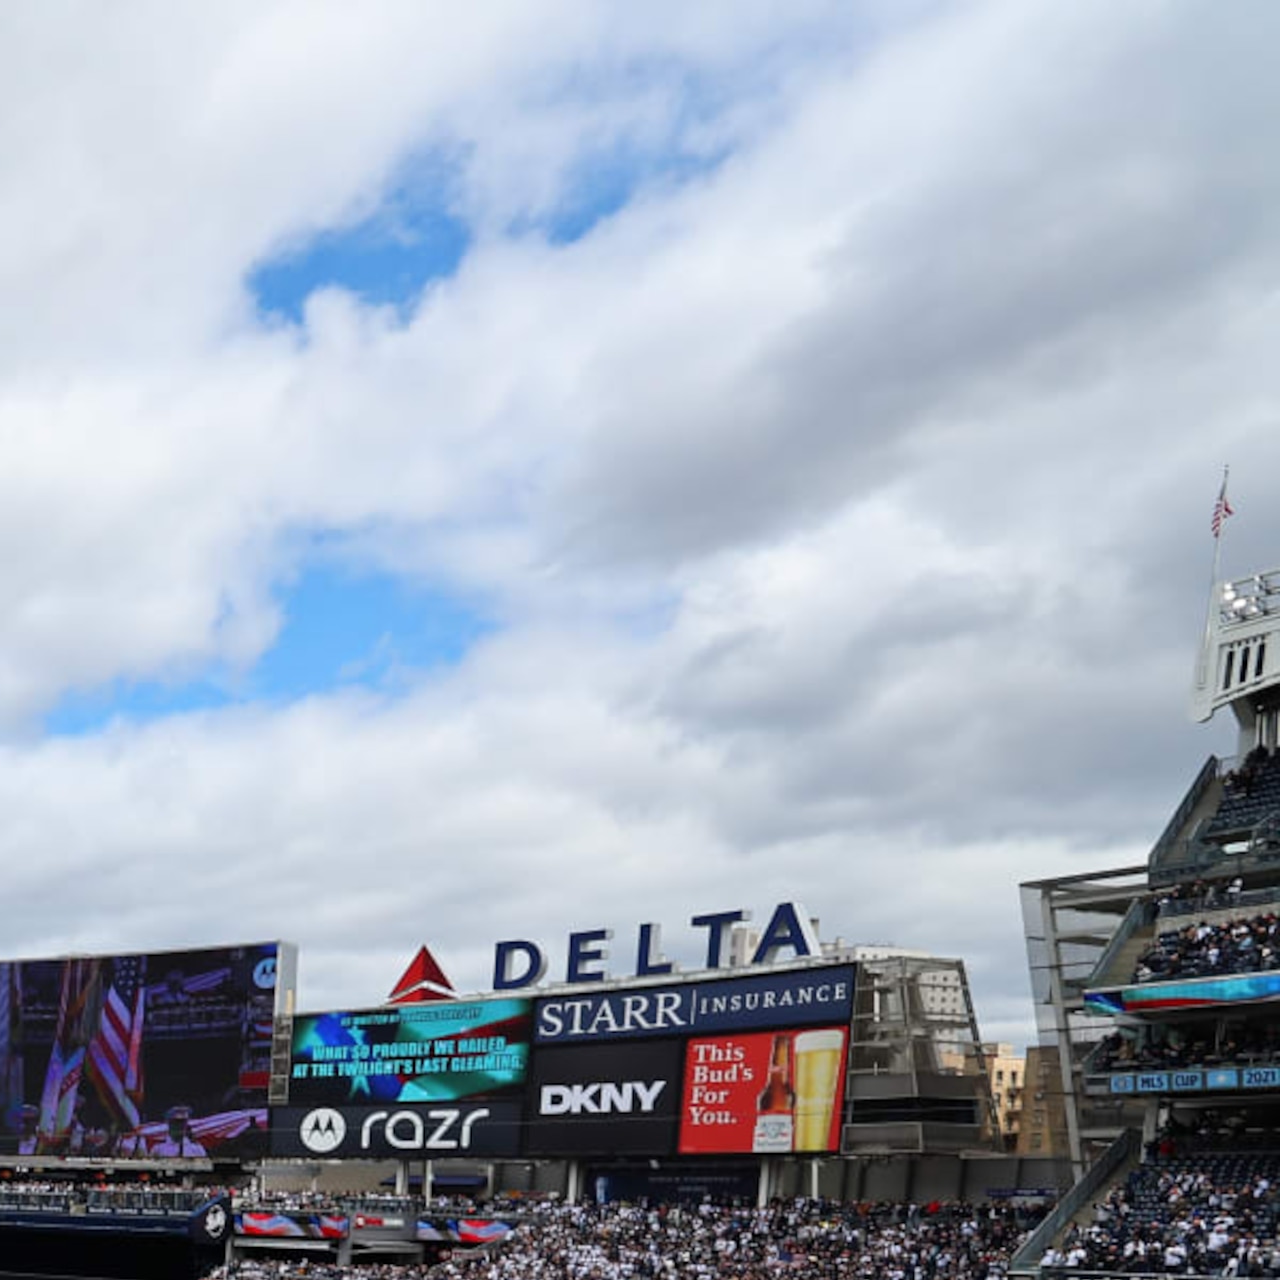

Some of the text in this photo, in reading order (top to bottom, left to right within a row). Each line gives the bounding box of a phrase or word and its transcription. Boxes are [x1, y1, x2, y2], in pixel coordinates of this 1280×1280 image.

[493, 900, 818, 990] DELTA
[539, 983, 847, 1036] STARR INSURANCE
[313, 1046, 349, 1061] WHAT
[352, 1044, 370, 1059] SO
[373, 1041, 432, 1058] PROUDLY
[434, 1040, 456, 1054] WE
[693, 1044, 745, 1063] This
[293, 1064, 309, 1078] AT
[312, 1063, 335, 1077] THE
[415, 1057, 446, 1073] LAST
[693, 1063, 754, 1084] Bud's
[1246, 1070, 1277, 1085] 2021
[1141, 1074, 1199, 1089] MLS CUP
[540, 1080, 667, 1115] DKNY
[691, 1087, 730, 1105] For
[689, 1107, 738, 1125] You.
[361, 1108, 490, 1150] razr
